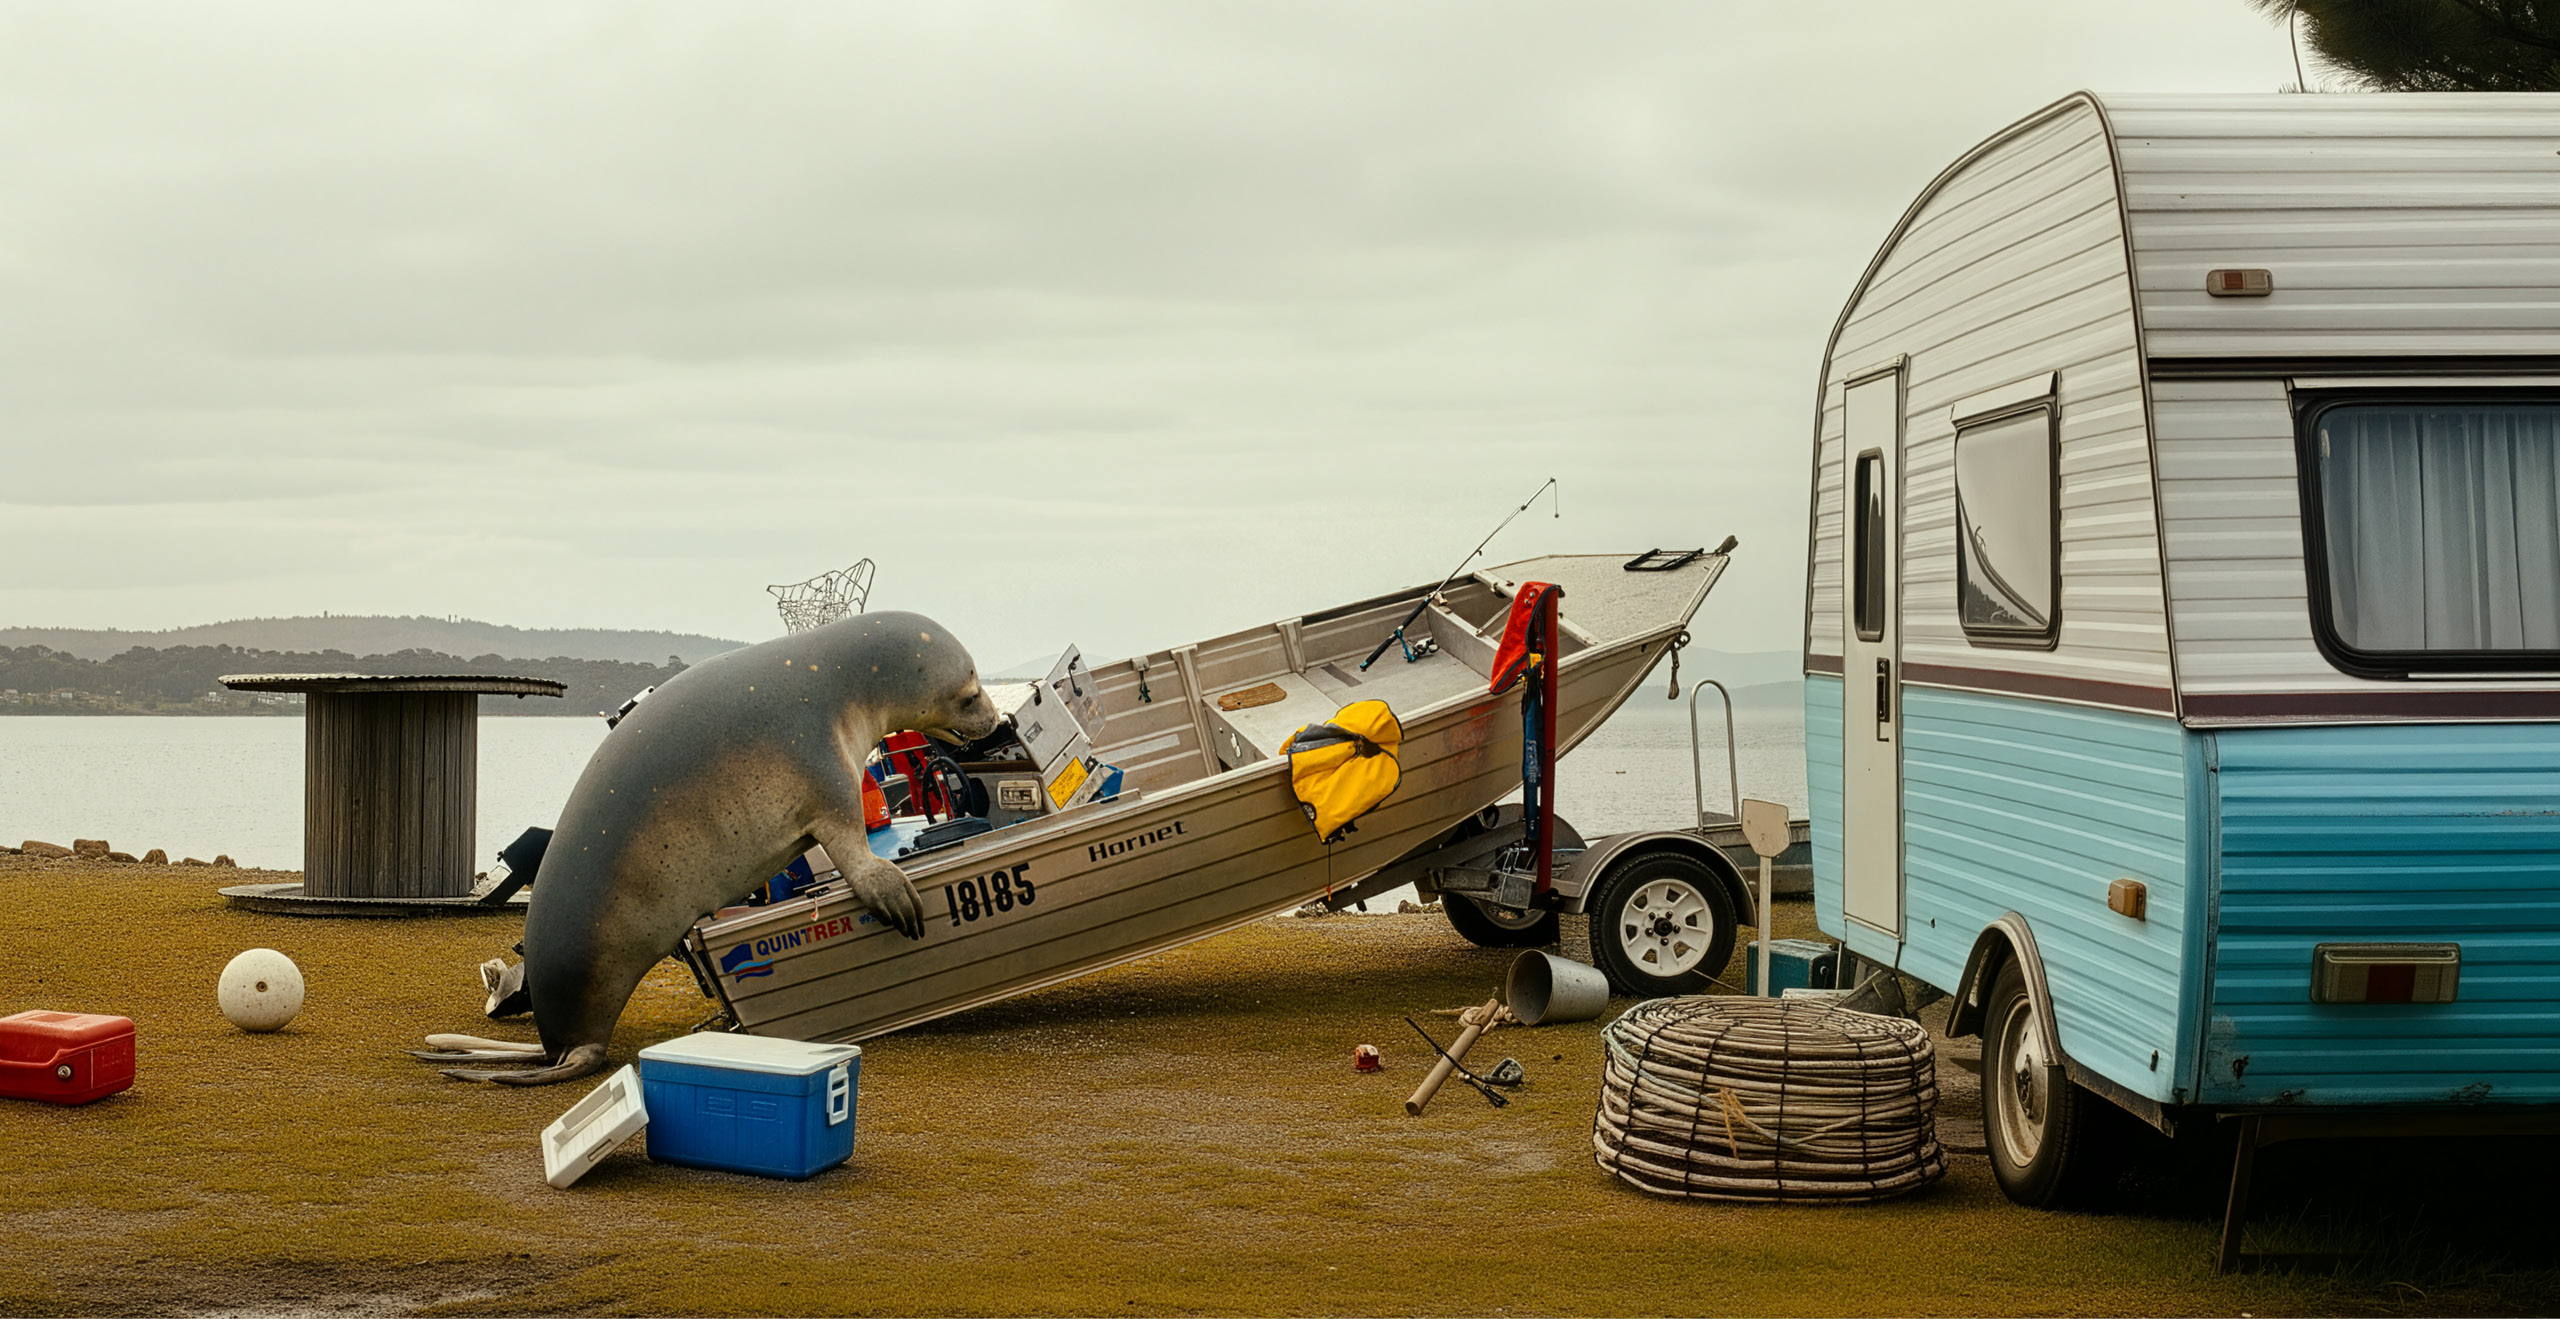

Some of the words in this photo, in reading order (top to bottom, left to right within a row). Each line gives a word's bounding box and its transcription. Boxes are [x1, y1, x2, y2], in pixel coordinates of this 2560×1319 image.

[1087, 820, 1188, 862] Hornet
[944, 862, 1036, 927] 18185
[756, 915, 854, 957] QUINTREX
